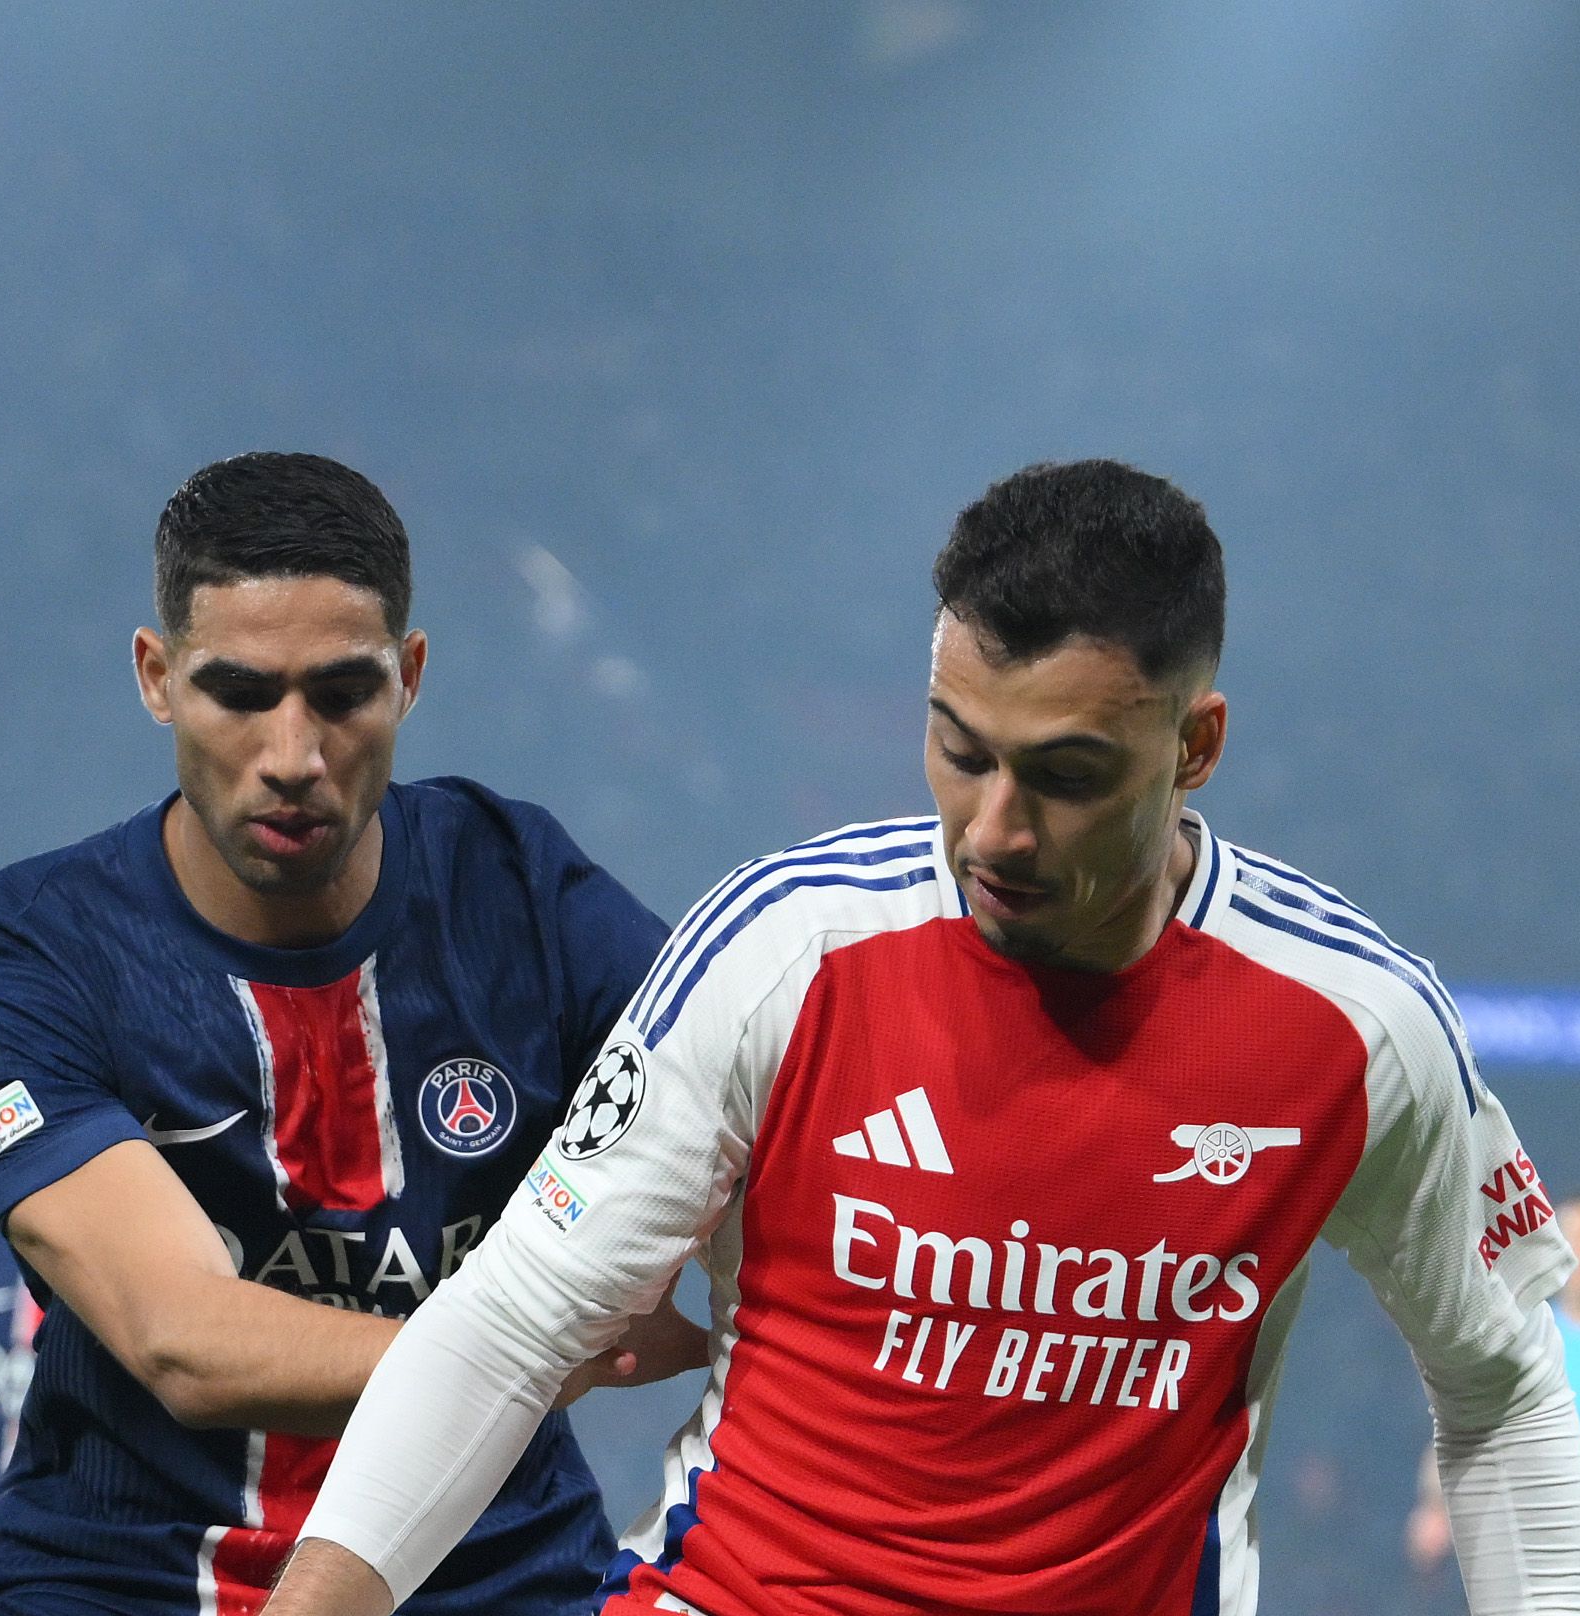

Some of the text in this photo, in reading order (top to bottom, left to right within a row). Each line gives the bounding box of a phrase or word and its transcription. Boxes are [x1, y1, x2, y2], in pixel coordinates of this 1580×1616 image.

[430, 1062, 495, 1089] PARIS
[9, 1117, 39, 1138] children
[469, 1123, 503, 1148] GERMAIN
[832, 1192, 1260, 1322] Emirates
[873, 1309, 1191, 1410] FLY BETTER
